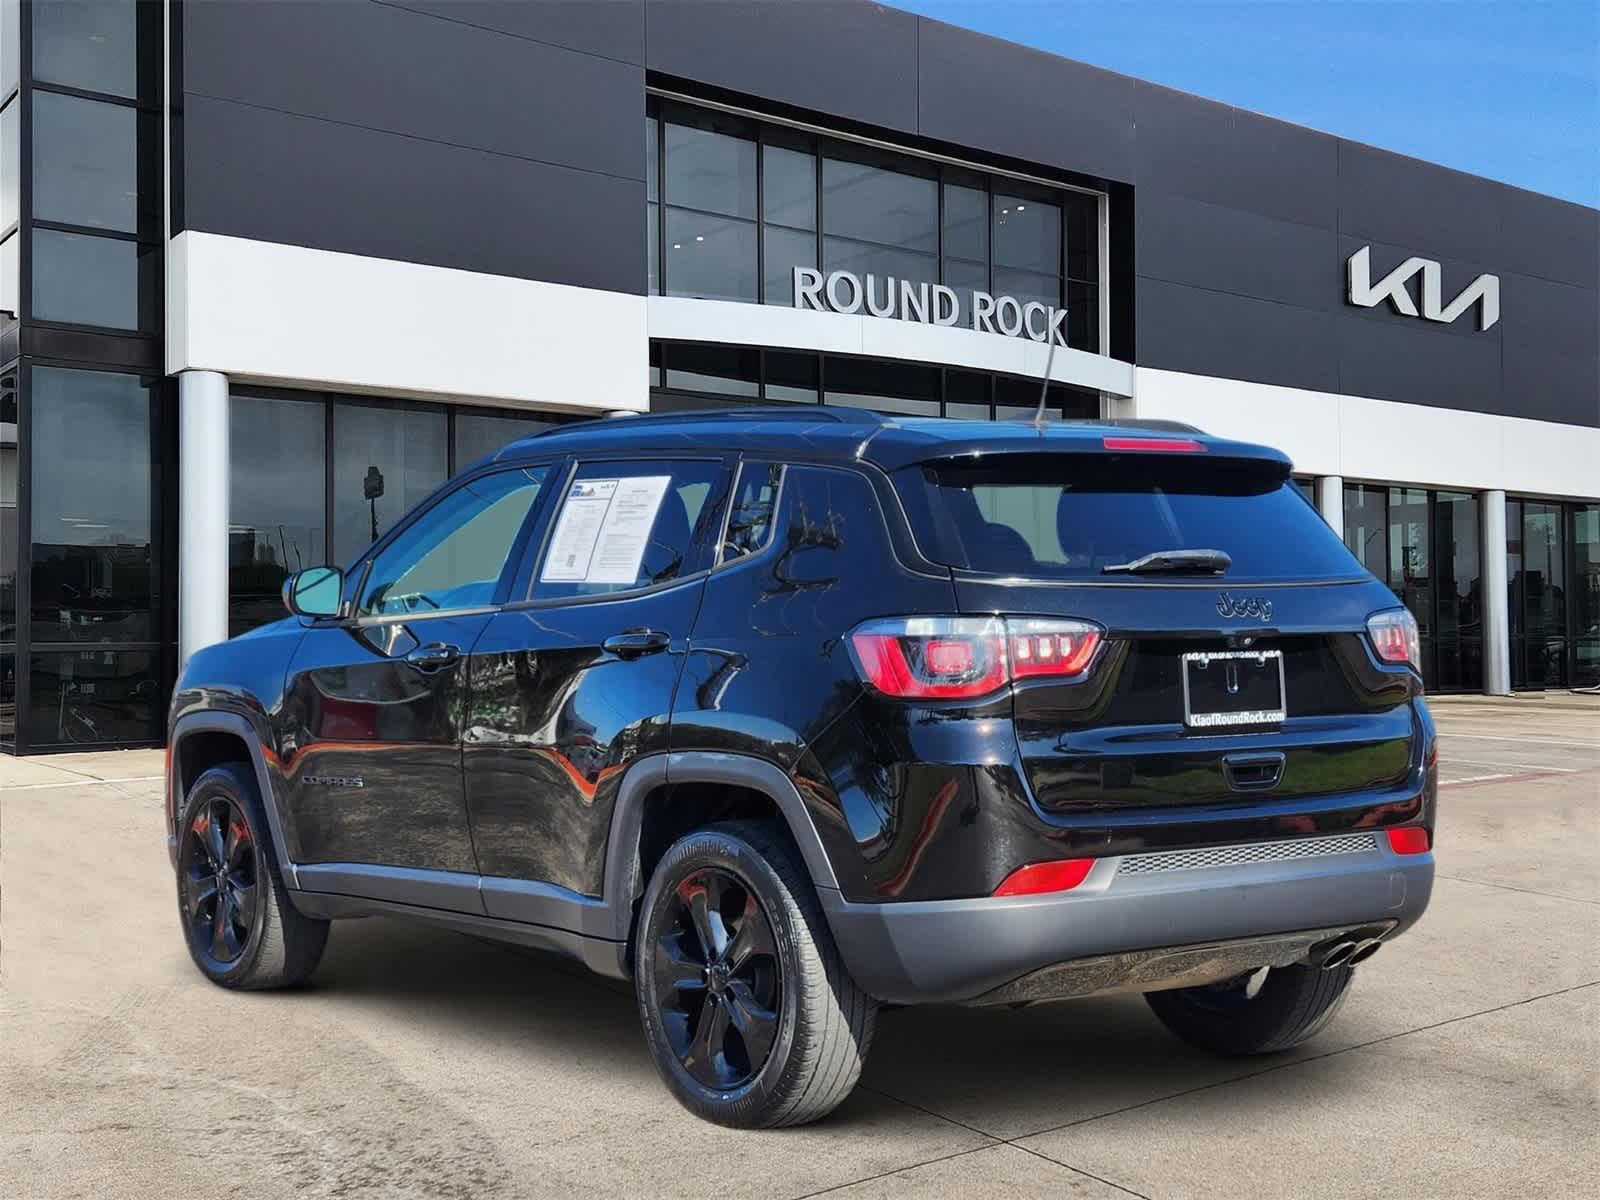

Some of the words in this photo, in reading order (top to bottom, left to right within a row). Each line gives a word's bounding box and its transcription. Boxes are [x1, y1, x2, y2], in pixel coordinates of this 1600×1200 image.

[792, 266, 960, 328] ROUND
[970, 290, 1069, 348] ROCK
[1216, 592, 1272, 621] Jeep
